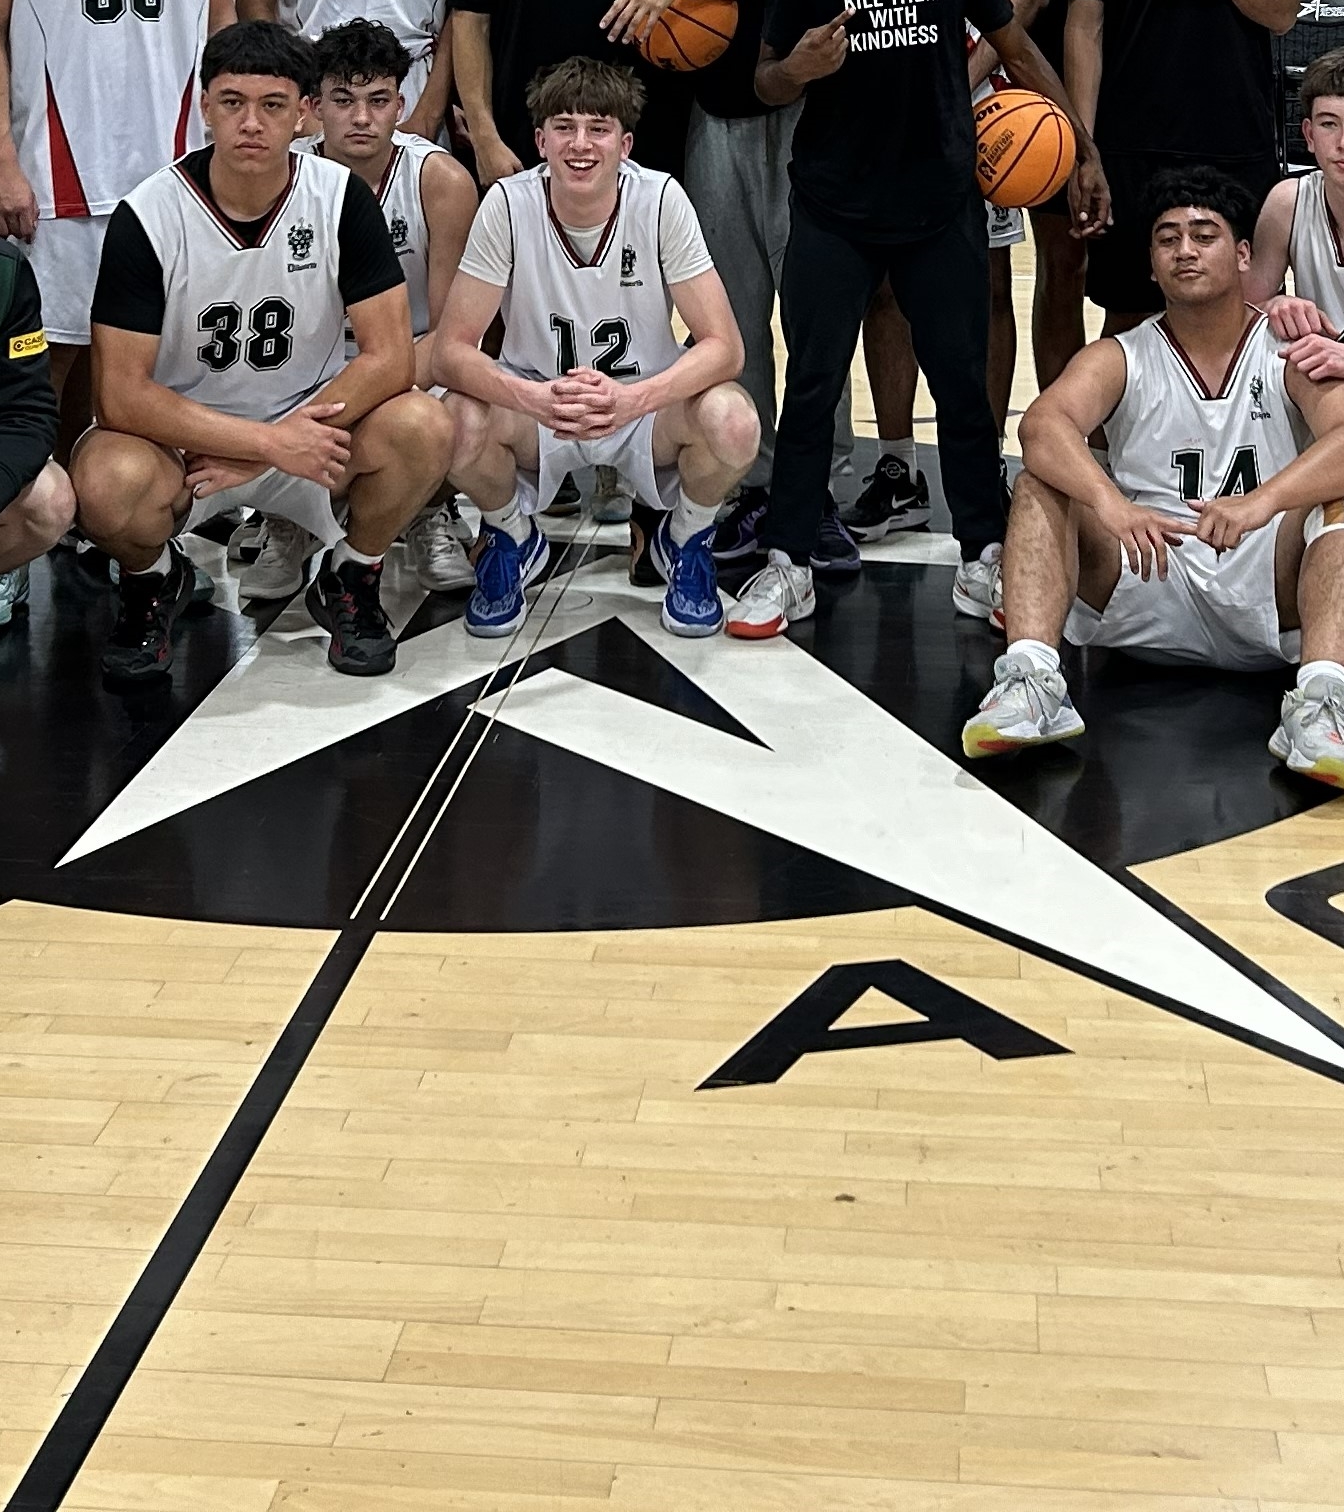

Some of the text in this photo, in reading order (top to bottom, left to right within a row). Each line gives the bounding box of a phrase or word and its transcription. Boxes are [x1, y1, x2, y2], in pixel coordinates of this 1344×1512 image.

[849, 24, 939, 53] KINDNESS
[868, 4, 918, 29] WITH
[197, 295, 295, 373] 38
[549, 312, 642, 378] 12
[1171, 444, 1263, 502] 14
